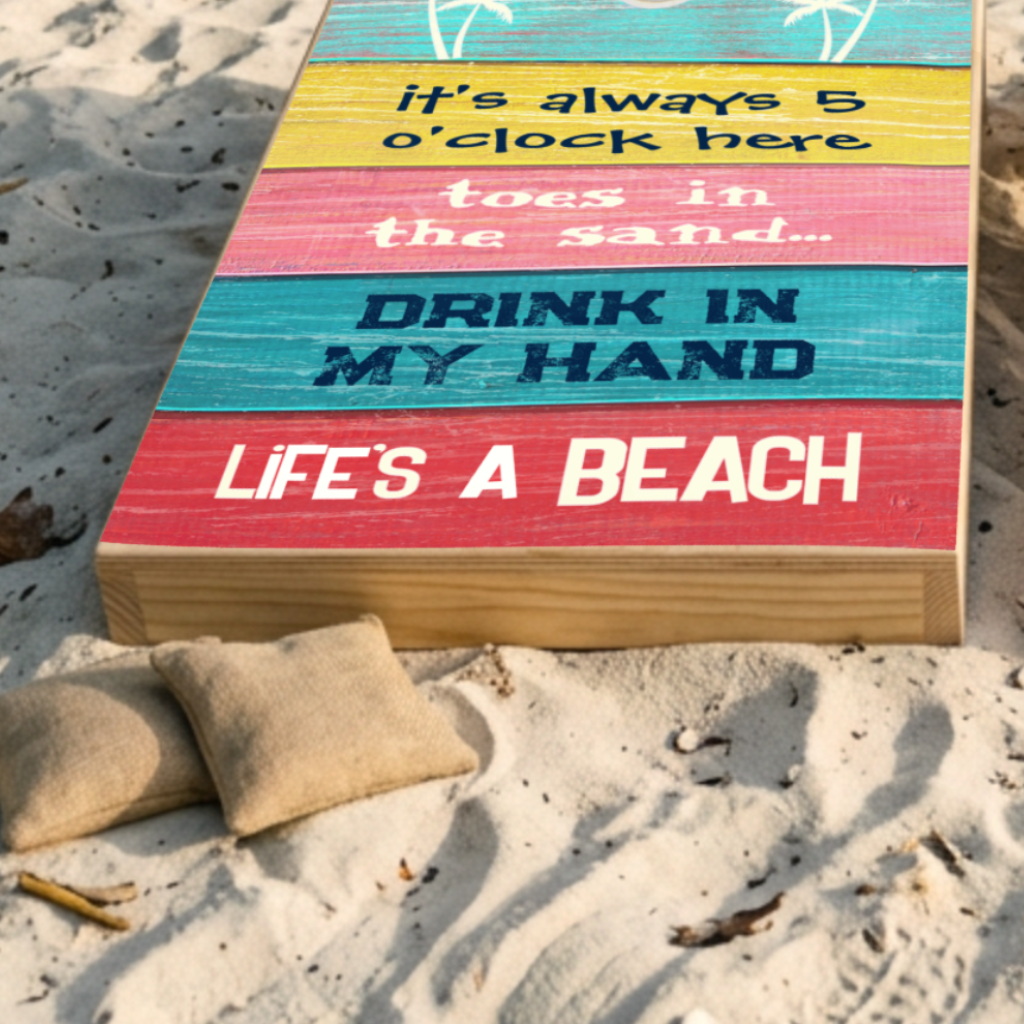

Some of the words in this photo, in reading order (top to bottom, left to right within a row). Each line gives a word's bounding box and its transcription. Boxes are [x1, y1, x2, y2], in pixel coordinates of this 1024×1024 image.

[396, 84, 508, 115] it's
[539, 86, 782, 116] always
[815, 90, 867, 114] 5
[382, 126, 663, 154] o'clock
[694, 126, 873, 152] here
[438, 179, 627, 209] toes
[675, 180, 776, 207] in
[365, 217, 505, 248] the
[356, 289, 667, 330] DRINK
[704, 288, 800, 324] IN
[312, 343, 483, 387] MY
[516, 338, 816, 383] HAND
[459, 444, 519, 500] A
[557, 432, 863, 507] BEACH
